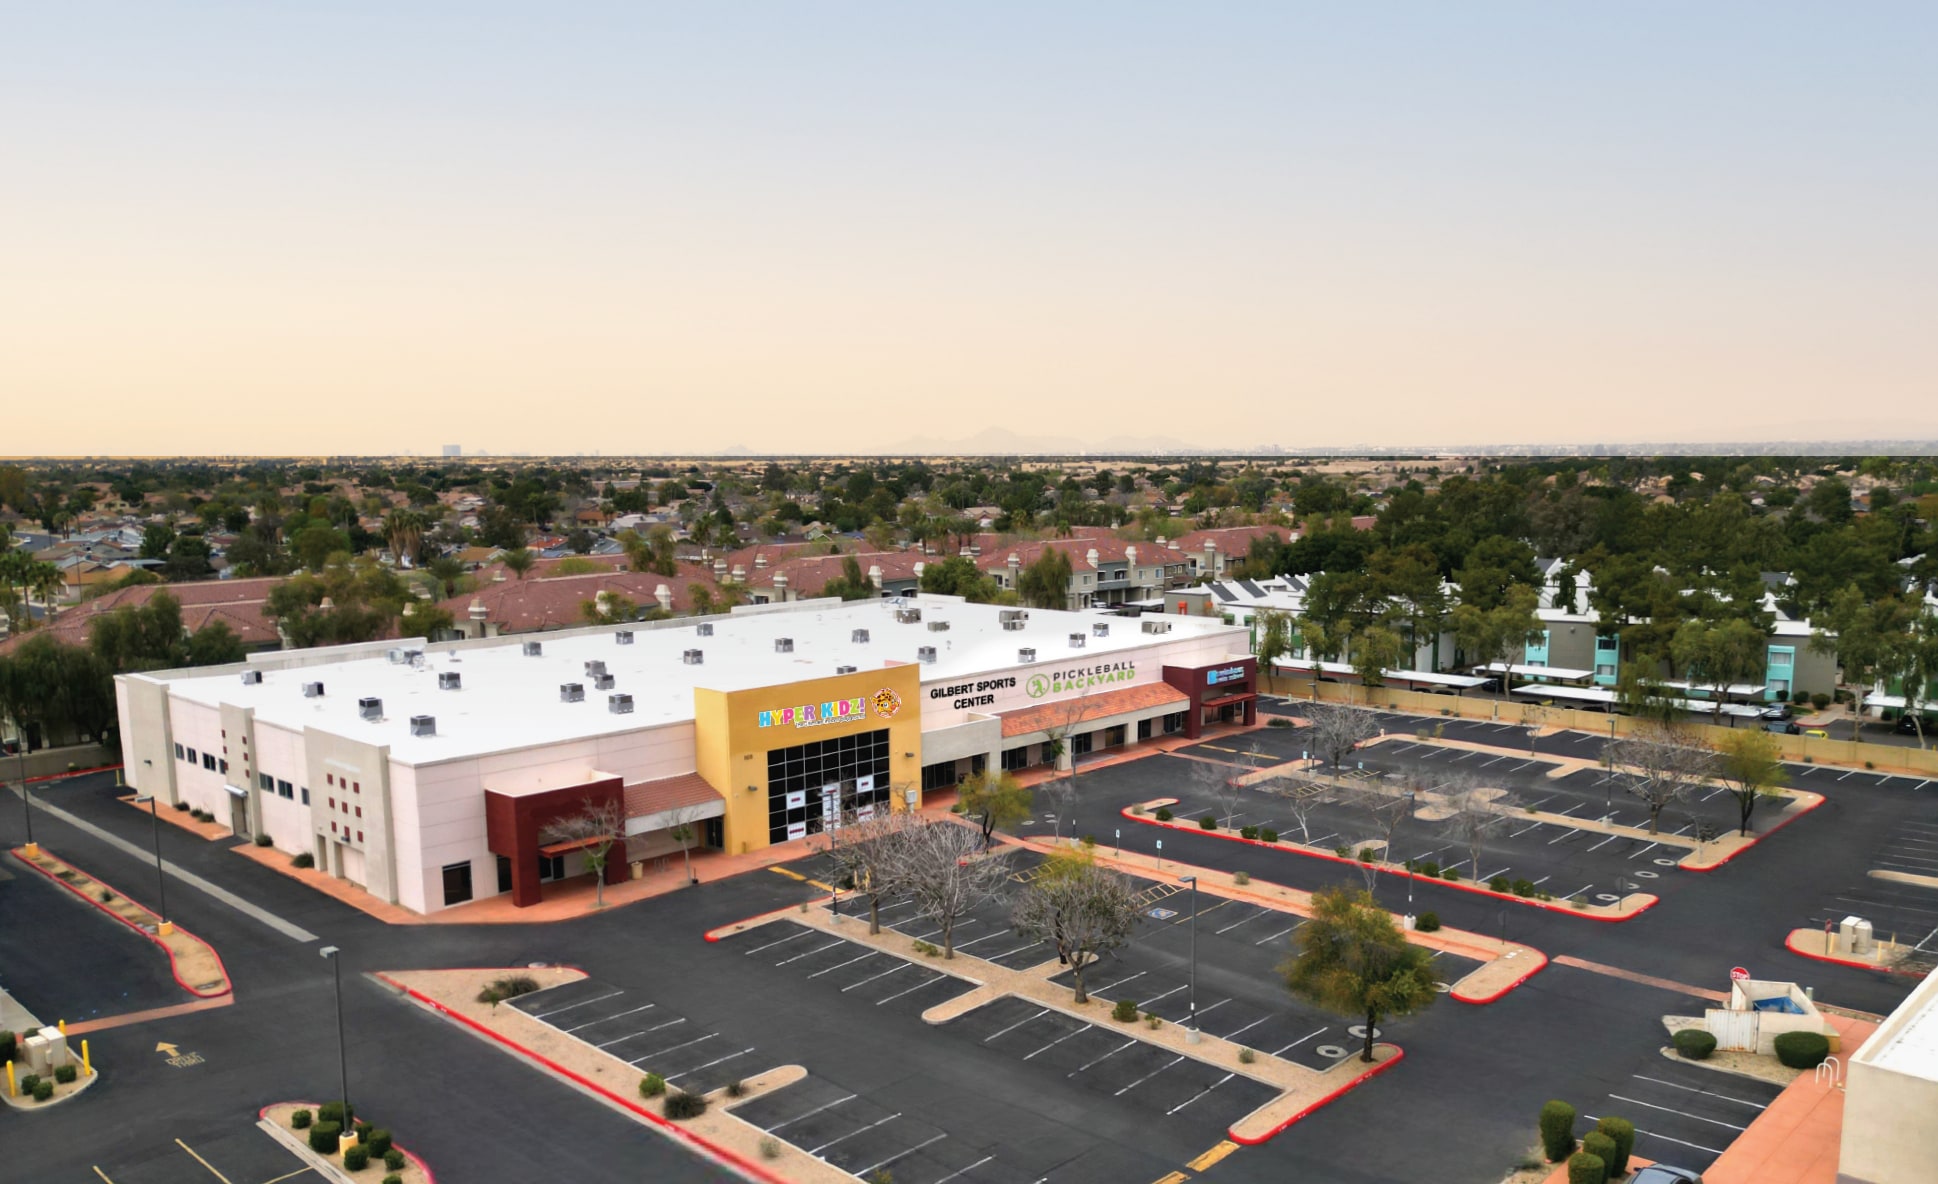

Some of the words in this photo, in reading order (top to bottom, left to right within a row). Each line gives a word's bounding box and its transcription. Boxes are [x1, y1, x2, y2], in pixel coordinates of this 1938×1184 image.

[1053, 661, 1136, 681] PICKLEBALL
[1053, 669, 1136, 693] BACKYARD
[930, 683, 974, 699] GILBERT
[977, 677, 1016, 692] SPORTS
[759, 704, 816, 727] HYPER
[821, 698, 865, 719] KIDZ!
[954, 694, 994, 710] CENTER
[1731, 971, 1749, 980] STOP
